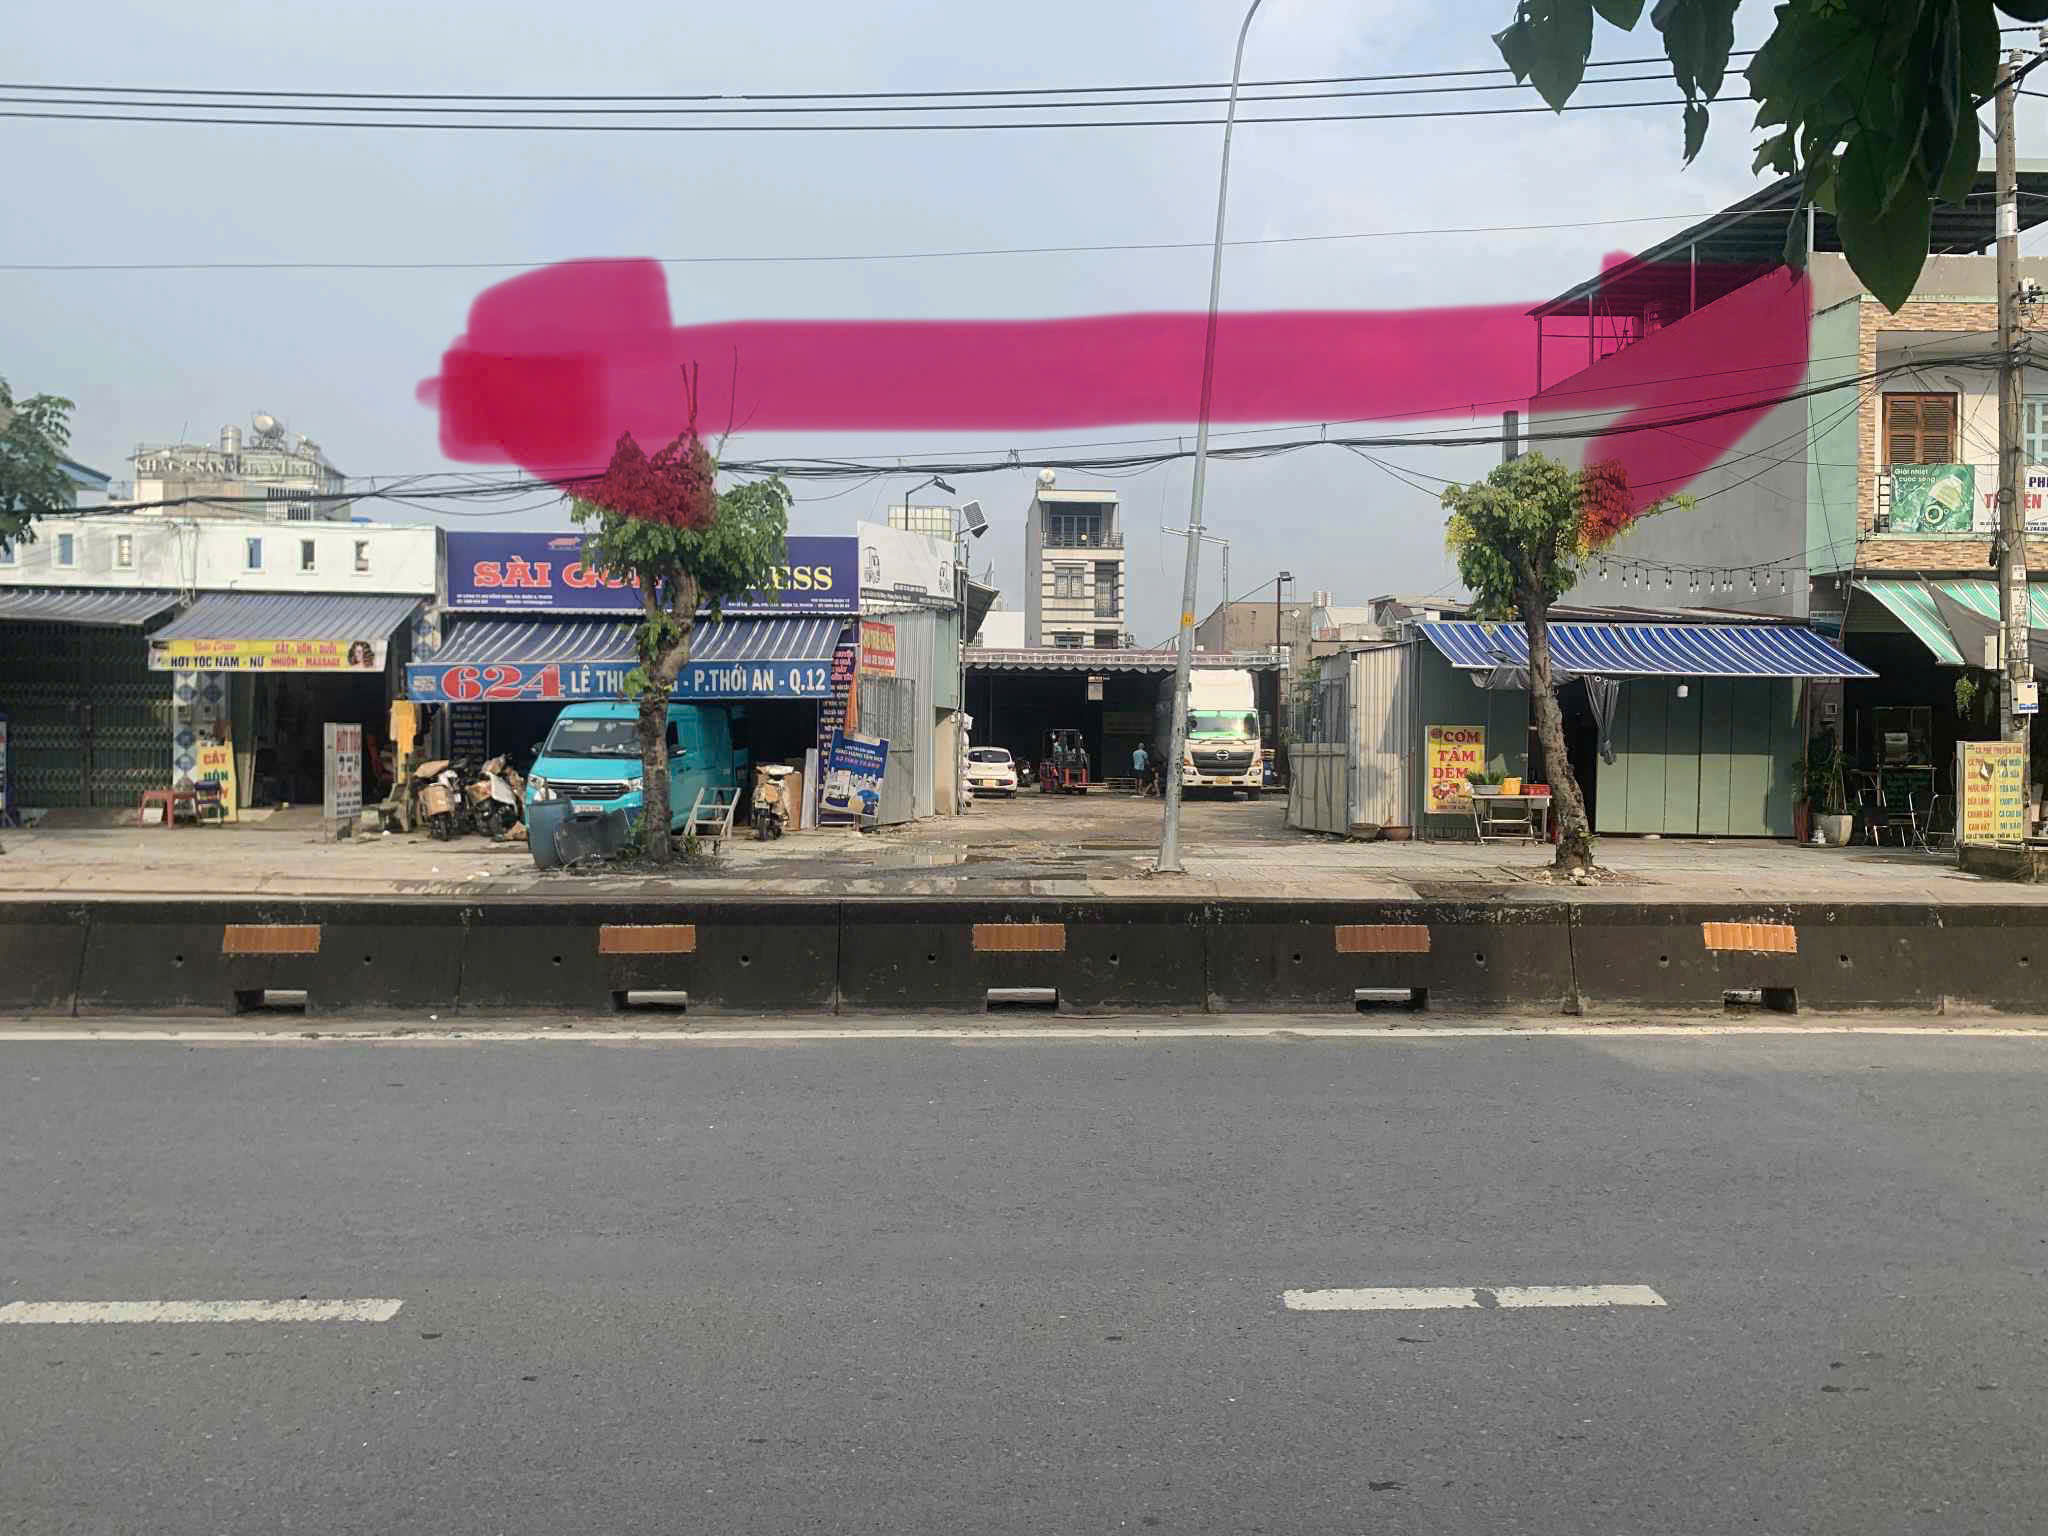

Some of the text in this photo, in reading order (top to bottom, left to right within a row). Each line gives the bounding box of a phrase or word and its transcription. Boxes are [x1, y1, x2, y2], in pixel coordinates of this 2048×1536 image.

[473, 555, 552, 588] SÀI
[215, 655, 240, 667] NAM
[441, 664, 566, 700] 624
[570, 664, 590, 693] LÊ
[694, 663, 747, 692] P.THỚI
[752, 669, 774, 692] AN
[789, 668, 826, 694] Q.12
[1444, 729, 1480, 743] CƠM
[203, 750, 226, 765] CẮT
[1438, 745, 1475, 762] TẤM
